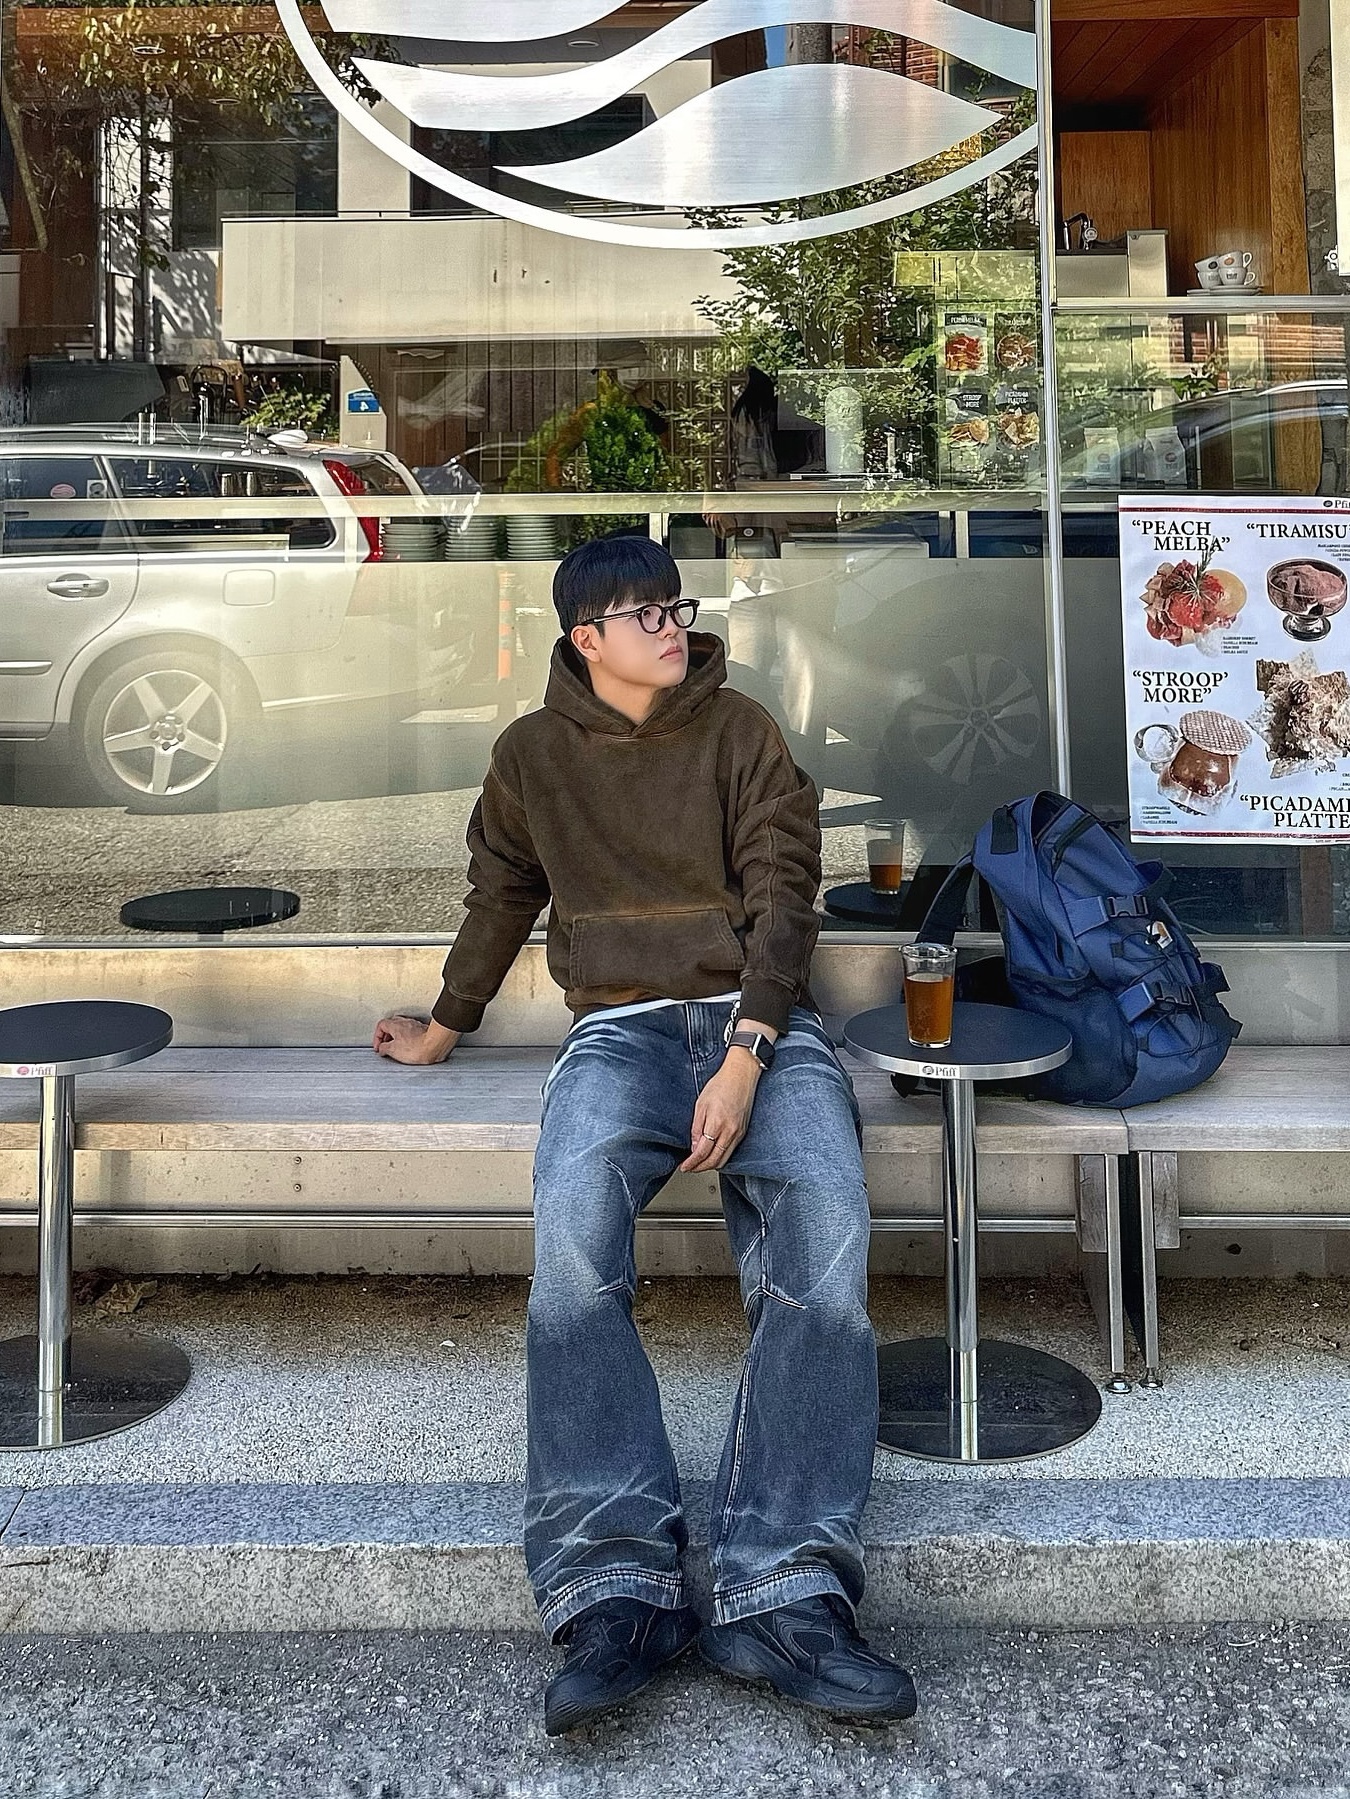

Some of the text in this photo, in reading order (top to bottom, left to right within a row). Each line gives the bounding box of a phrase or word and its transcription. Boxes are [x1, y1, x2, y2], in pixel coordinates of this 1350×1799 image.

[1132, 520, 1211, 536] “PEACH
[1154, 536, 1230, 552] MELBA”
[1143, 688, 1211, 703] MORE”
